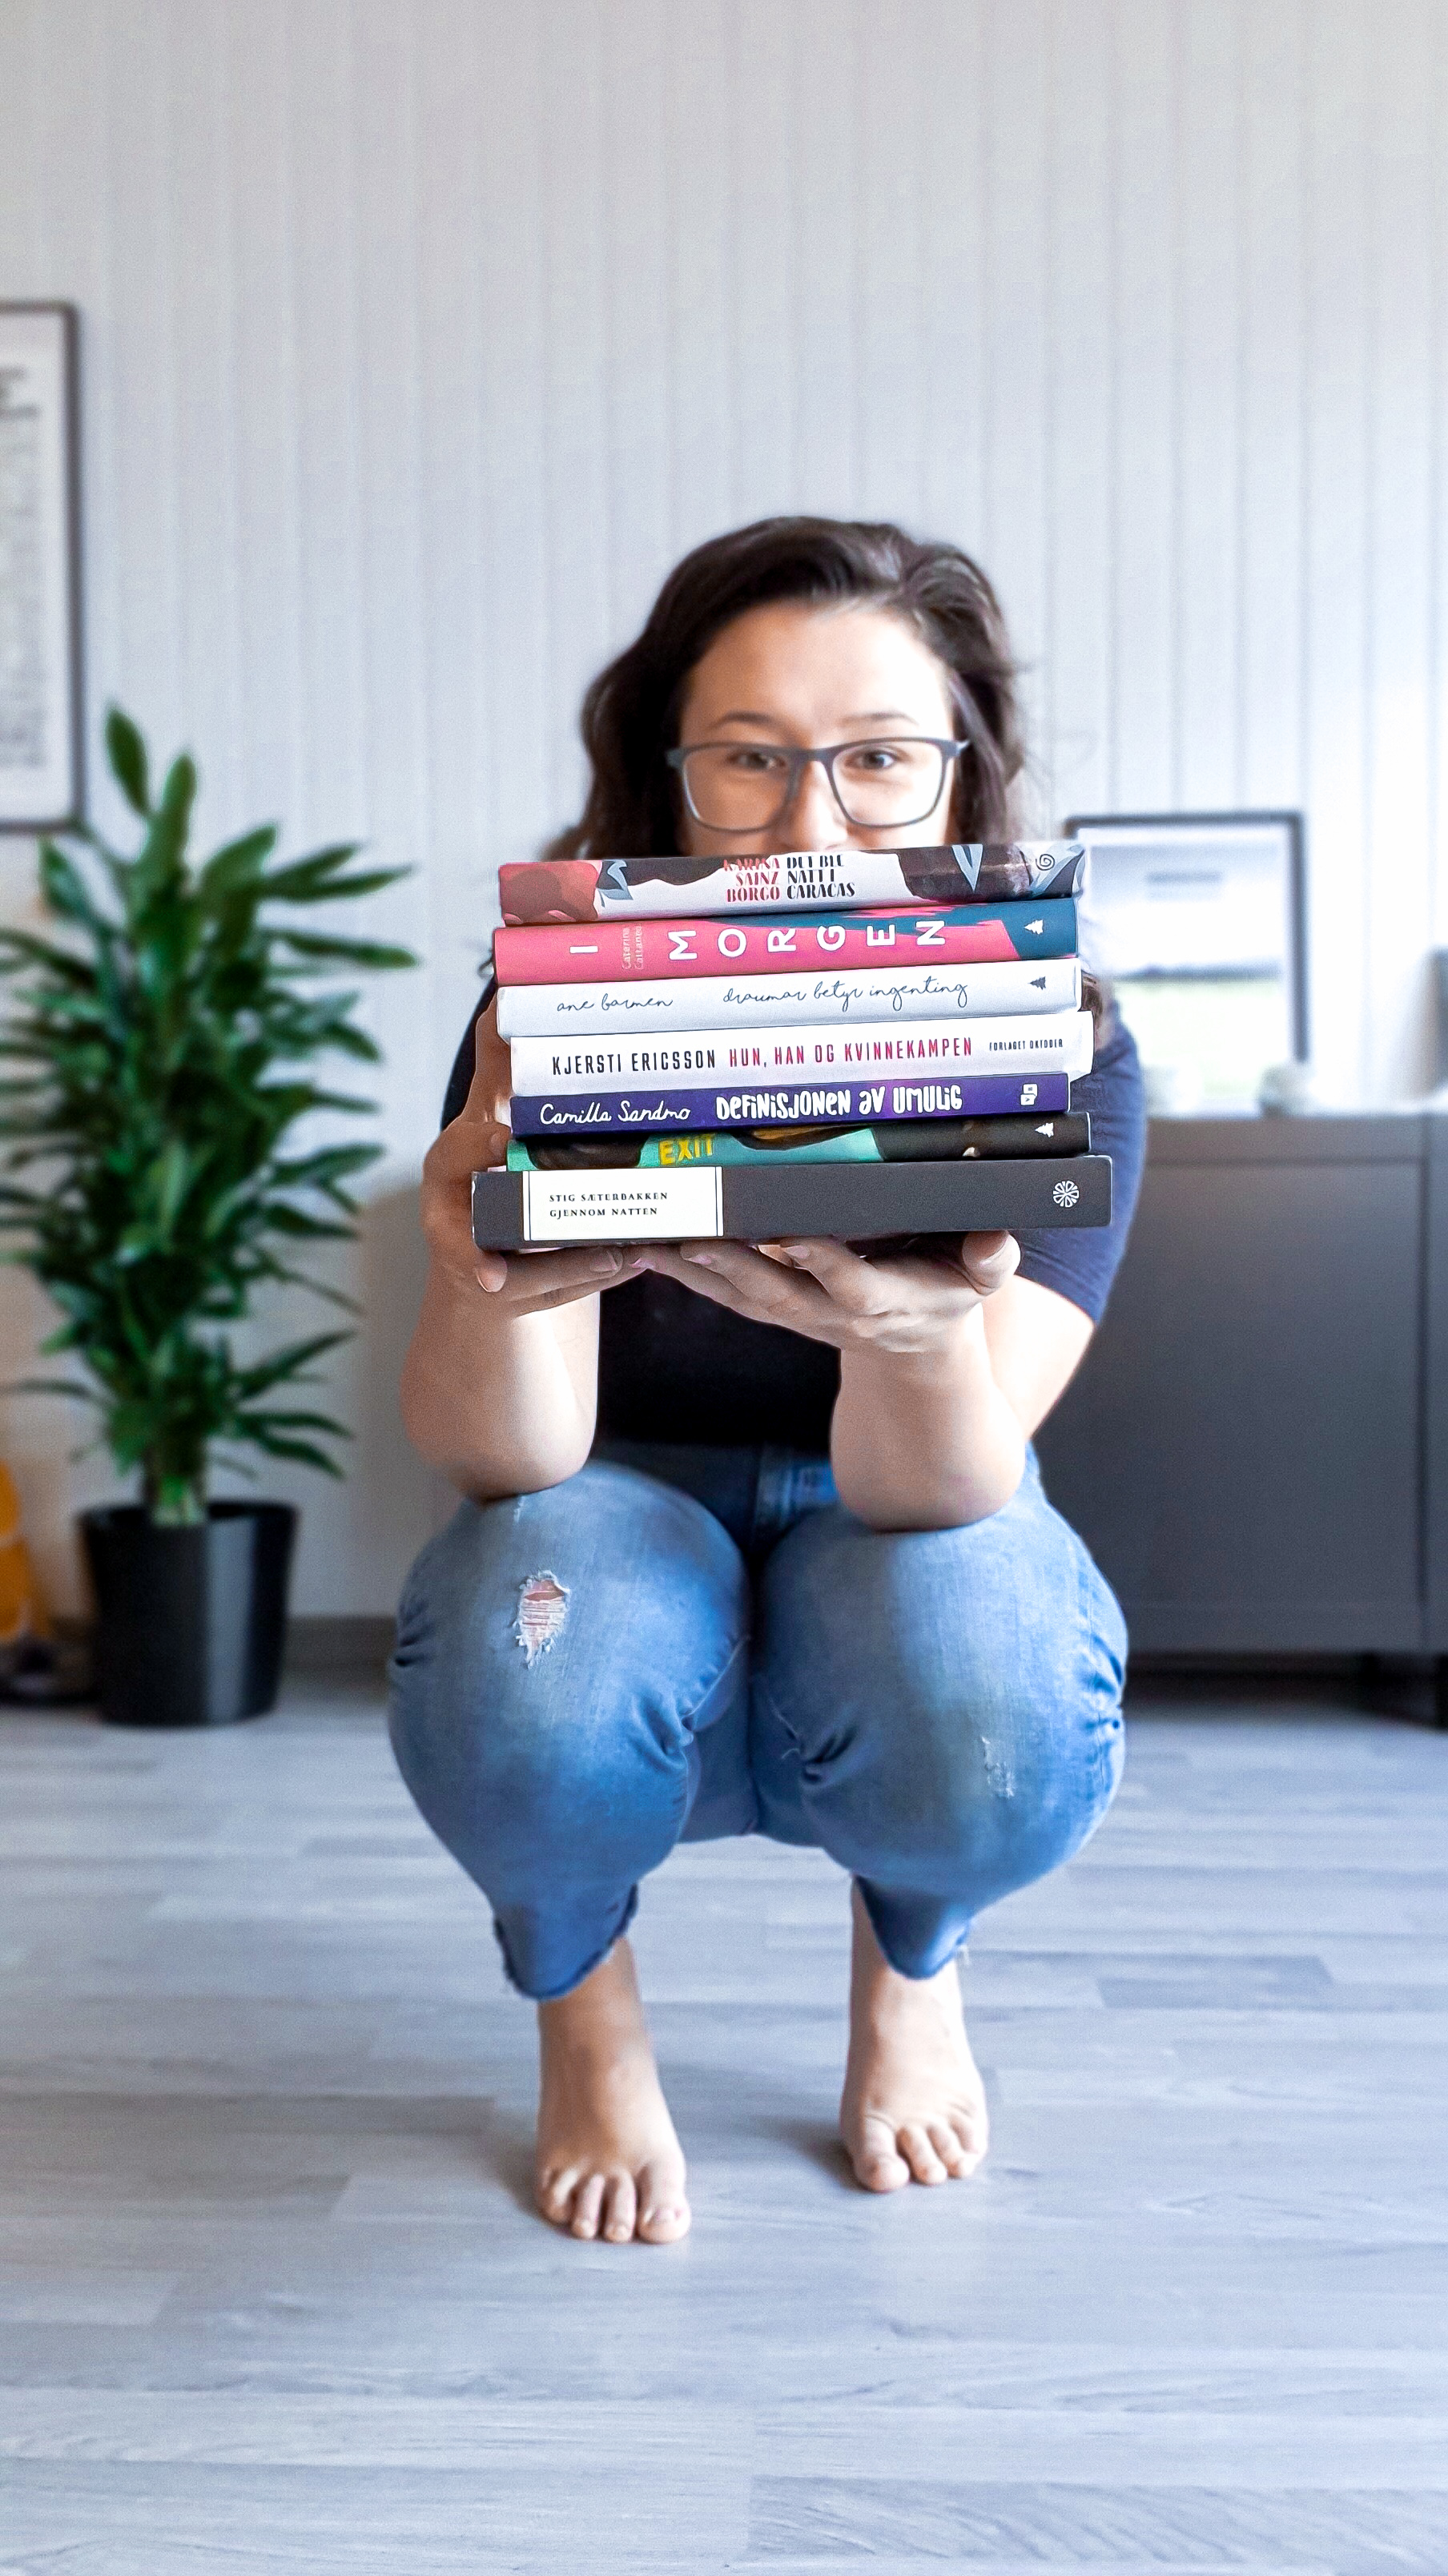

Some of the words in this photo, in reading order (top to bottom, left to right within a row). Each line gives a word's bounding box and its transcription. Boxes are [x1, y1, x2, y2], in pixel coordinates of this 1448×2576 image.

[736, 871, 779, 887] SAINZ
[787, 869, 825, 883] NATT
[829, 868, 835, 882] I
[726, 886, 781, 902] BORGO
[787, 882, 855, 900] CARACAS
[668, 920, 946, 961] MORGEN
[814, 980, 864, 1012] betyr
[869, 976, 968, 1012] ingenting
[552, 1053, 622, 1076] KJERSTI
[631, 1049, 715, 1073] ERICSSON
[729, 1048, 767, 1068] HUN,
[774, 1045, 805, 1065] HAN
[814, 1044, 835, 1063] OG
[844, 1037, 972, 1062] KVINNEKAMPEN
[989, 1040, 1026, 1051] FORLAGET
[540, 1102, 612, 1125] Camilla
[617, 1100, 691, 1121] Sandmo
[658, 1133, 715, 1166] EXIT
[549, 1193, 576, 1202] STIG
[549, 1208, 605, 1220] GJENNOM
[611, 1207, 658, 1216] NATTEN
